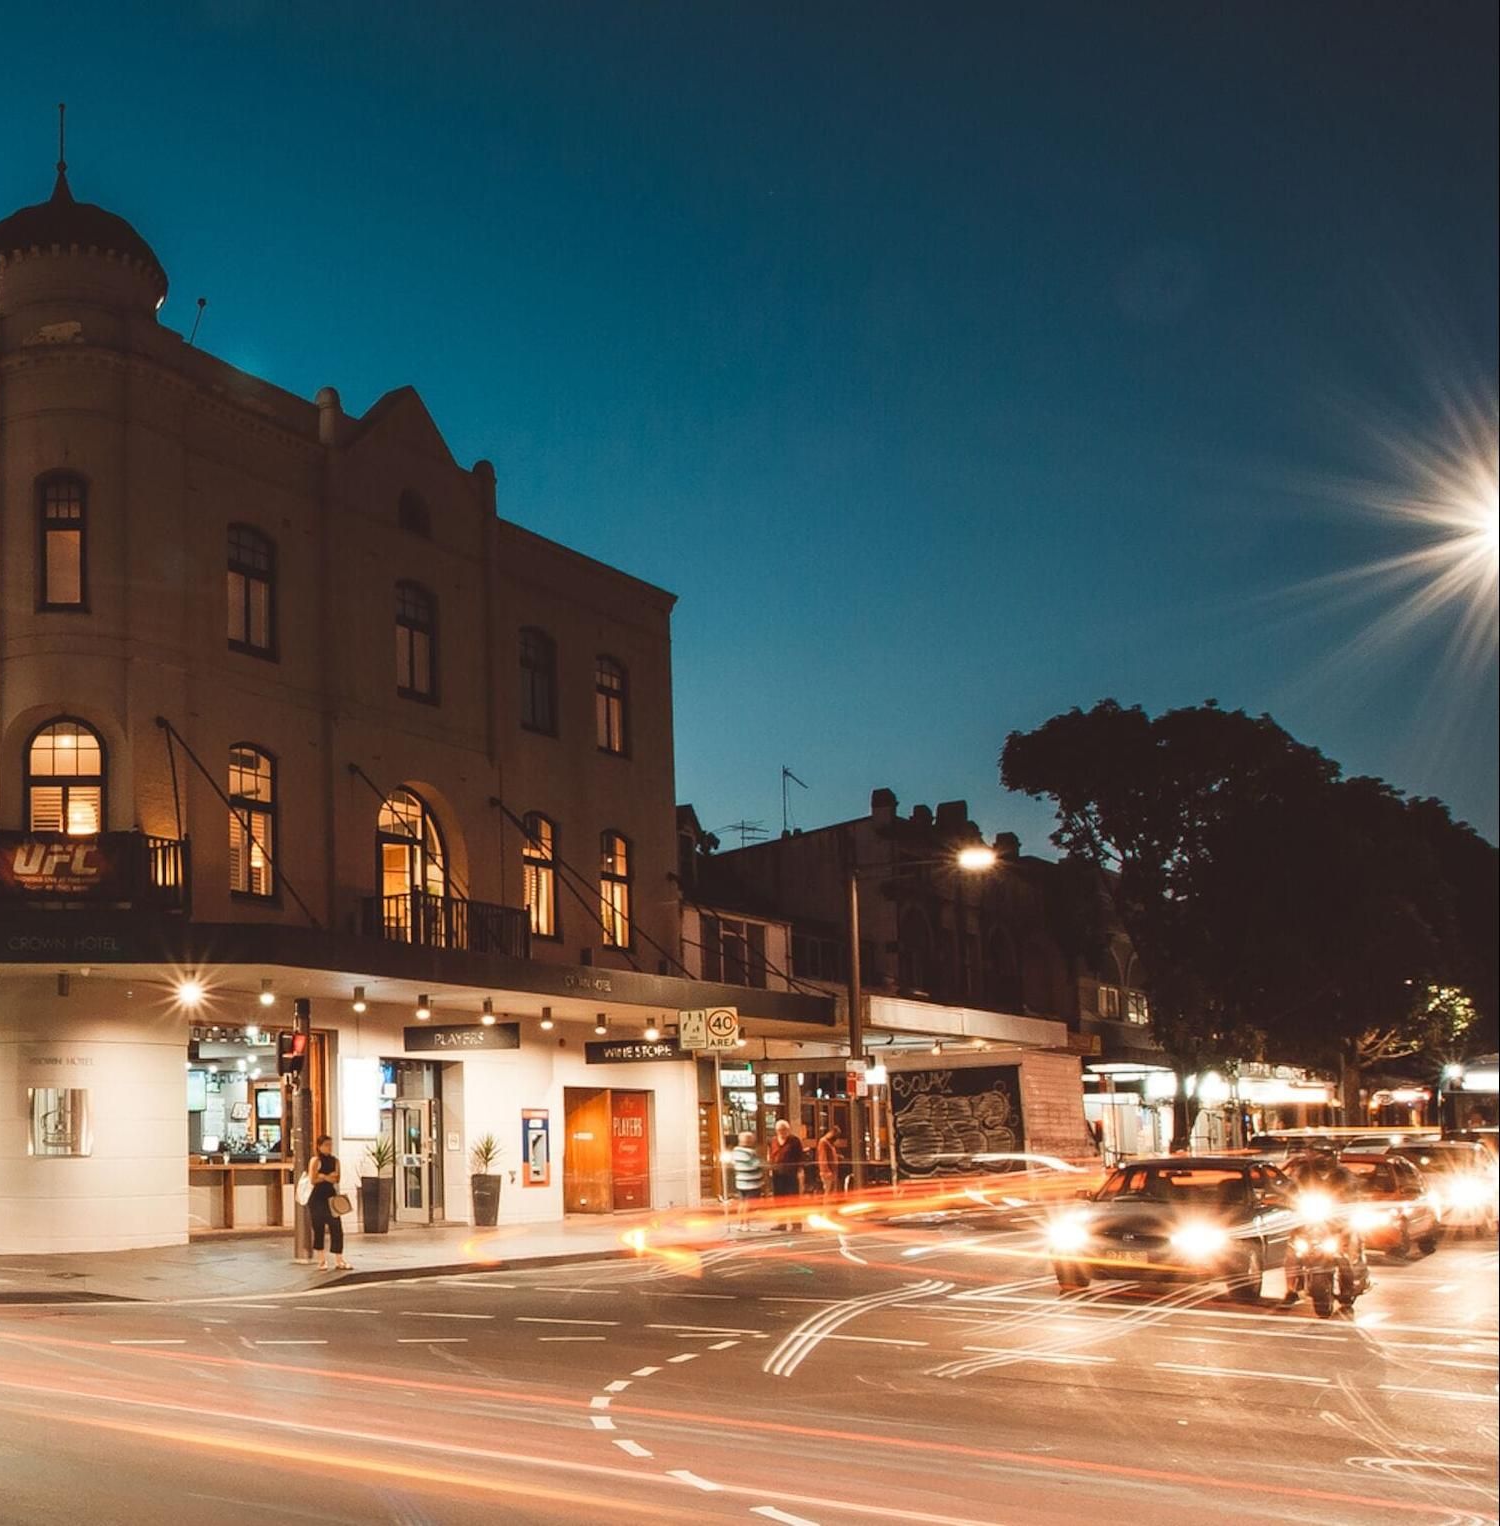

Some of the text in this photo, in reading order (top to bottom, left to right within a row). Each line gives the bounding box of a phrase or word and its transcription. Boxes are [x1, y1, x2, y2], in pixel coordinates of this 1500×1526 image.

[13, 844, 98, 874] UFC
[7, 936, 119, 950] CROWN HOTEL
[712, 1016, 732, 1030] 40
[434, 1032, 484, 1046] PLAYERS
[710, 1038, 736, 1046] AREA
[604, 1044, 672, 1058] WINE STORE
[66, 1057, 96, 1066] HOTEL
[613, 1116, 642, 1137] PLAYERS
